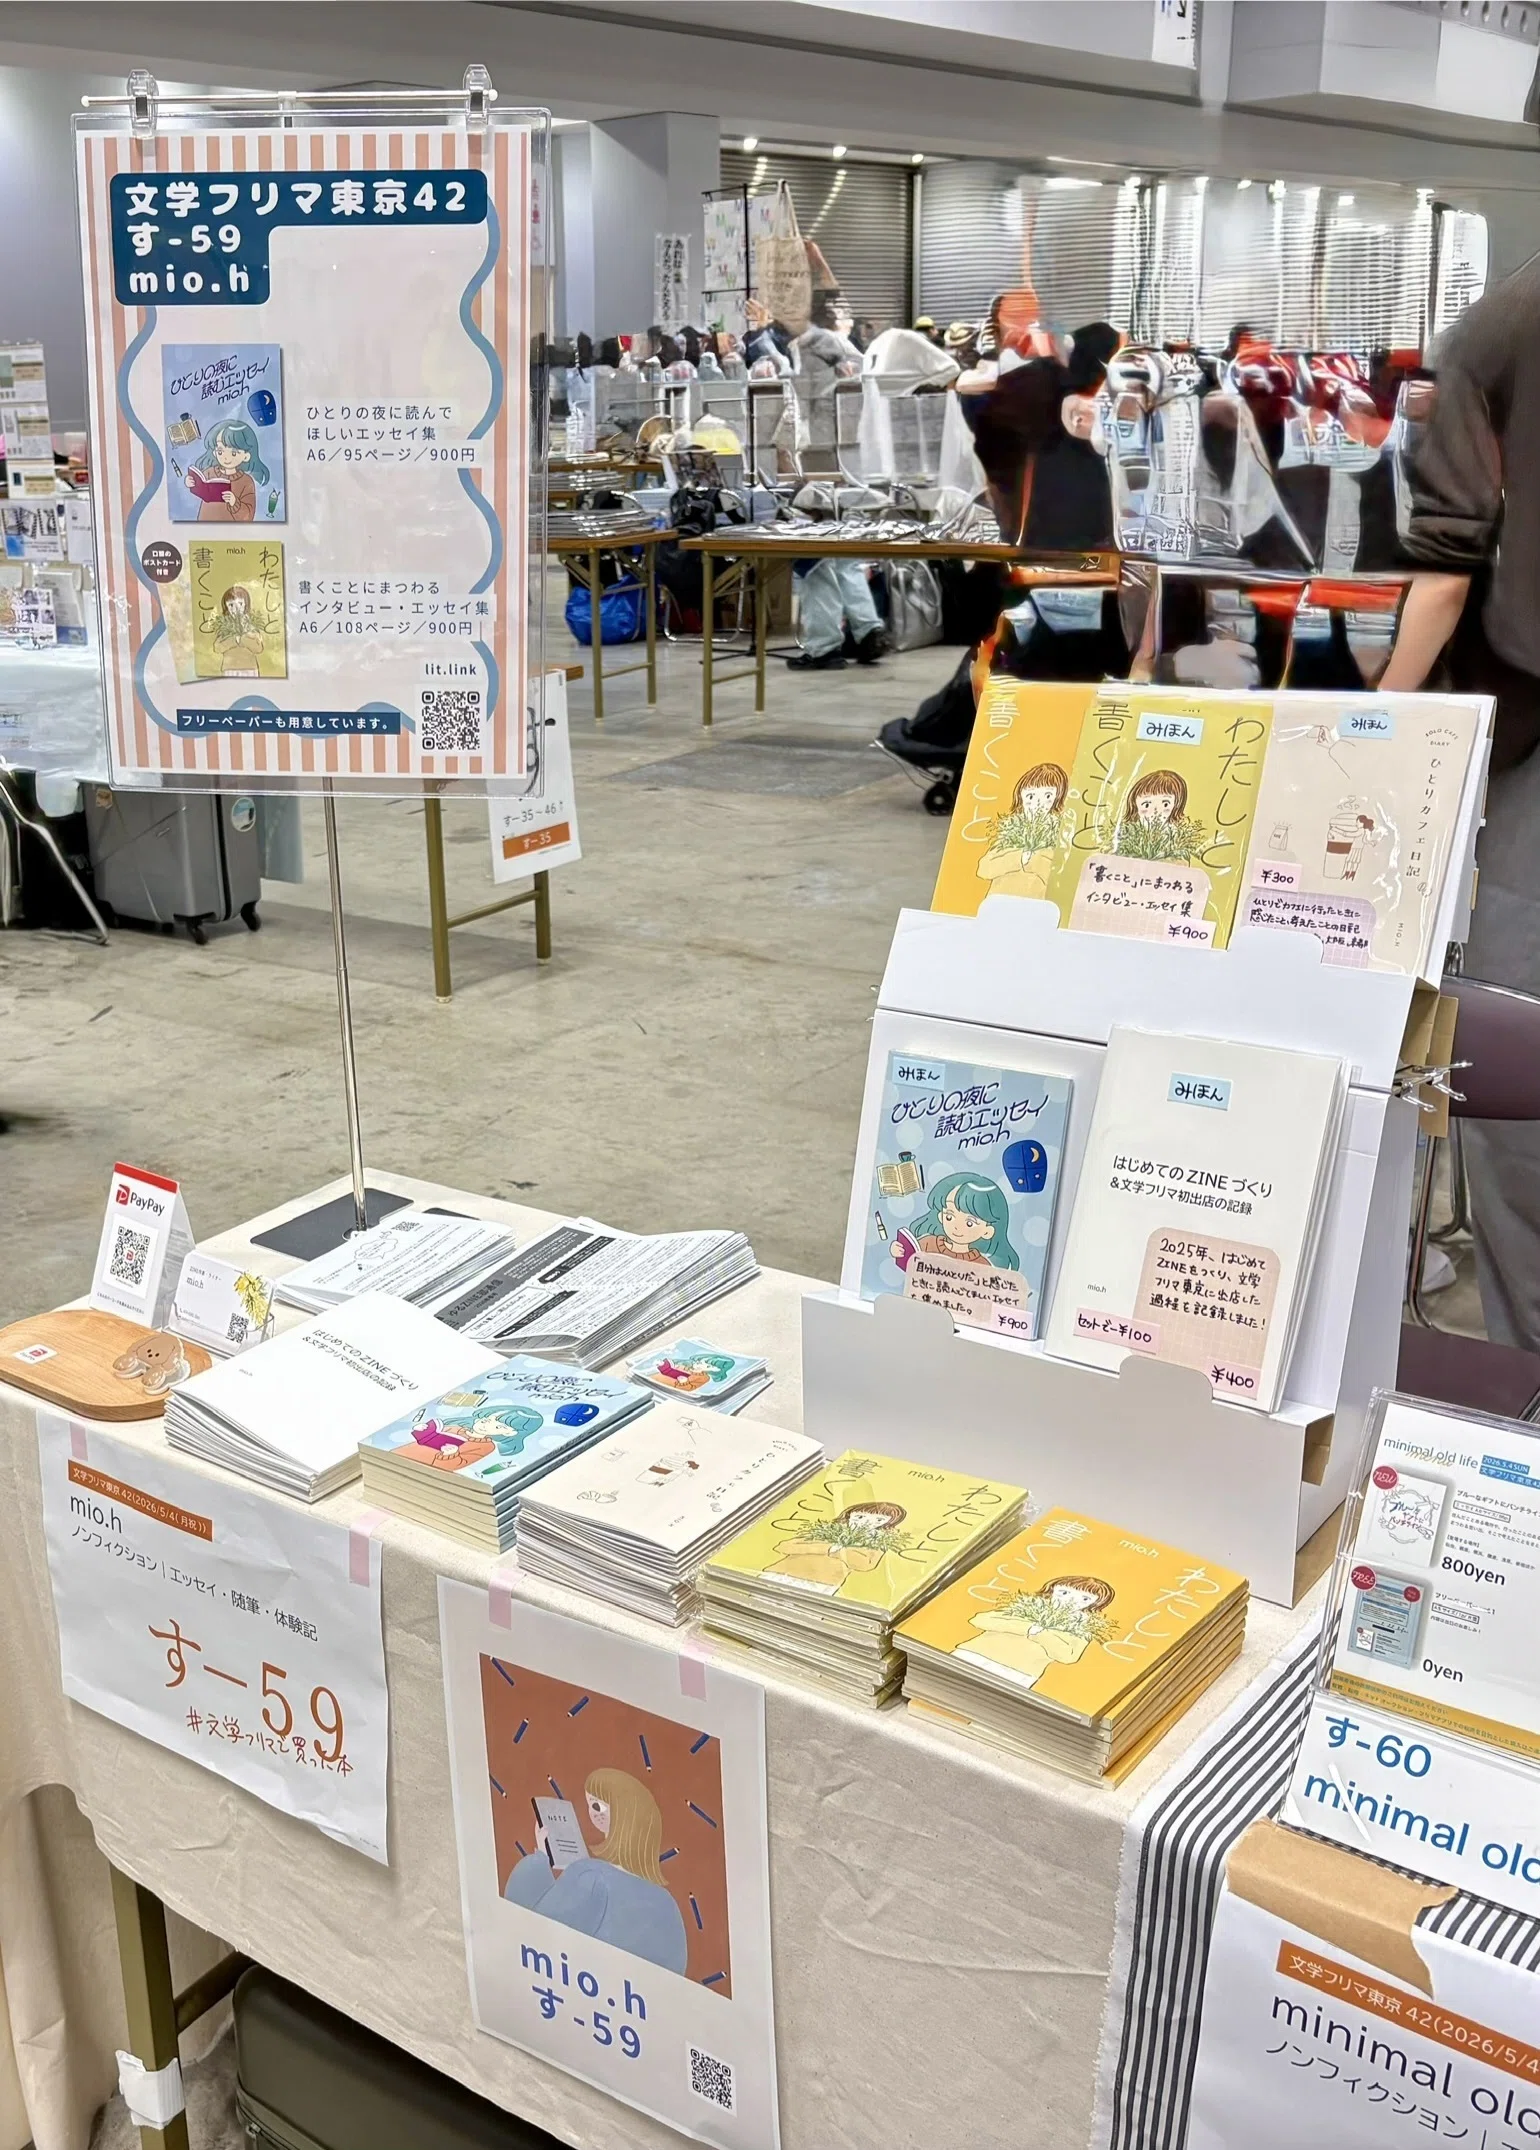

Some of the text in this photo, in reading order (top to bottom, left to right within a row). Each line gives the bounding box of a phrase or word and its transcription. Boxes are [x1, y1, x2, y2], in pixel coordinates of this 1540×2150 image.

[125, 178, 468, 218] 文学フリマ東京42
[127, 223, 242, 257] す-59
[129, 264, 250, 294] mio.h
[170, 354, 238, 396] ひとりの夜に
[201, 357, 270, 400] 読むエッセイ
[217, 384, 250, 406] mio.h
[306, 405, 452, 421] ひとりの夜に読んで
[306, 426, 437, 442] ほしいエッセイ集
[226, 547, 246, 555] mio.h
[192, 547, 215, 634] 書くこと
[259, 546, 281, 635] わたしと
[298, 580, 440, 595] 書くことにまつわる
[299, 600, 490, 617] インタビュー・エッセイ集
[424, 662, 477, 677] lit.link
[181, 714, 389, 732] フリーペーパーも用意しています。
[1146, 721, 1195, 739] みほん
[1351, 717, 1388, 731] みほん
[1201, 717, 1265, 868] わたしと
[1405, 758, 1441, 877] ひとりカフェ日記
[1089, 862, 1193, 894] 「書くこと」にまつわる
[1261, 869, 1294, 884] ¥300
[1086, 892, 1193, 918] インタビュー・エッセイ集
[1253, 898, 1361, 918] ひとりでカフェに行ったときに
[1168, 924, 1208, 940] ¥900
[1250, 909, 1361, 935] 感じたこと、考えたことの日記
[898, 1065, 941, 1083] みほん
[891, 1081, 1000, 1124] ひとりの夜に
[1174, 1081, 1224, 1102] みほん
[934, 1093, 1050, 1139] 読むエッセイ
[958, 1128, 1011, 1151] mio.h
[130, 1191, 165, 1216] PayPay
[1109, 1177, 1254, 1217] &文学フリマ初出店の記録
[1159, 1237, 1268, 1271] 2025年、はじめて
[186, 1277, 204, 1289] mio.h
[914, 1256, 1020, 1291] 「自分はひとりだ」と感じた
[1155, 1257, 1262, 1289] ZINEをつくり、文学
[911, 1278, 1020, 1306] ときに読んでほしいエッセイ
[1087, 1282, 1107, 1293] mio.h
[1154, 1276, 1262, 1308] フリマ東京に出店した
[998, 1314, 1028, 1330] ¥900
[1211, 1363, 1255, 1390] ¥400
[1384, 1438, 1479, 1469] minimal old life
[907, 1469, 946, 1484] mio.h
[771, 1458, 884, 1533] 書くこと
[70, 1495, 122, 1534] mio.h
[897, 1483, 1003, 1565] わたしと
[967, 1519, 1094, 1604] 書くこと
[1119, 1538, 1160, 1559] mio.h
[1351, 1570, 1375, 1585] FREE
[1442, 1556, 1505, 1585] 800yen
[1101, 1567, 1222, 1664] わたしと
[1422, 1658, 1464, 1683] 0yen
[1325, 1715, 1432, 1778] す-60
[548, 1814, 568, 1823] NOTE
[1303, 1772, 1470, 1857] minimal
[521, 1943, 647, 2021] mio.h
[532, 1985, 642, 2060] す-59
[1271, 1996, 1453, 2099] minimal
